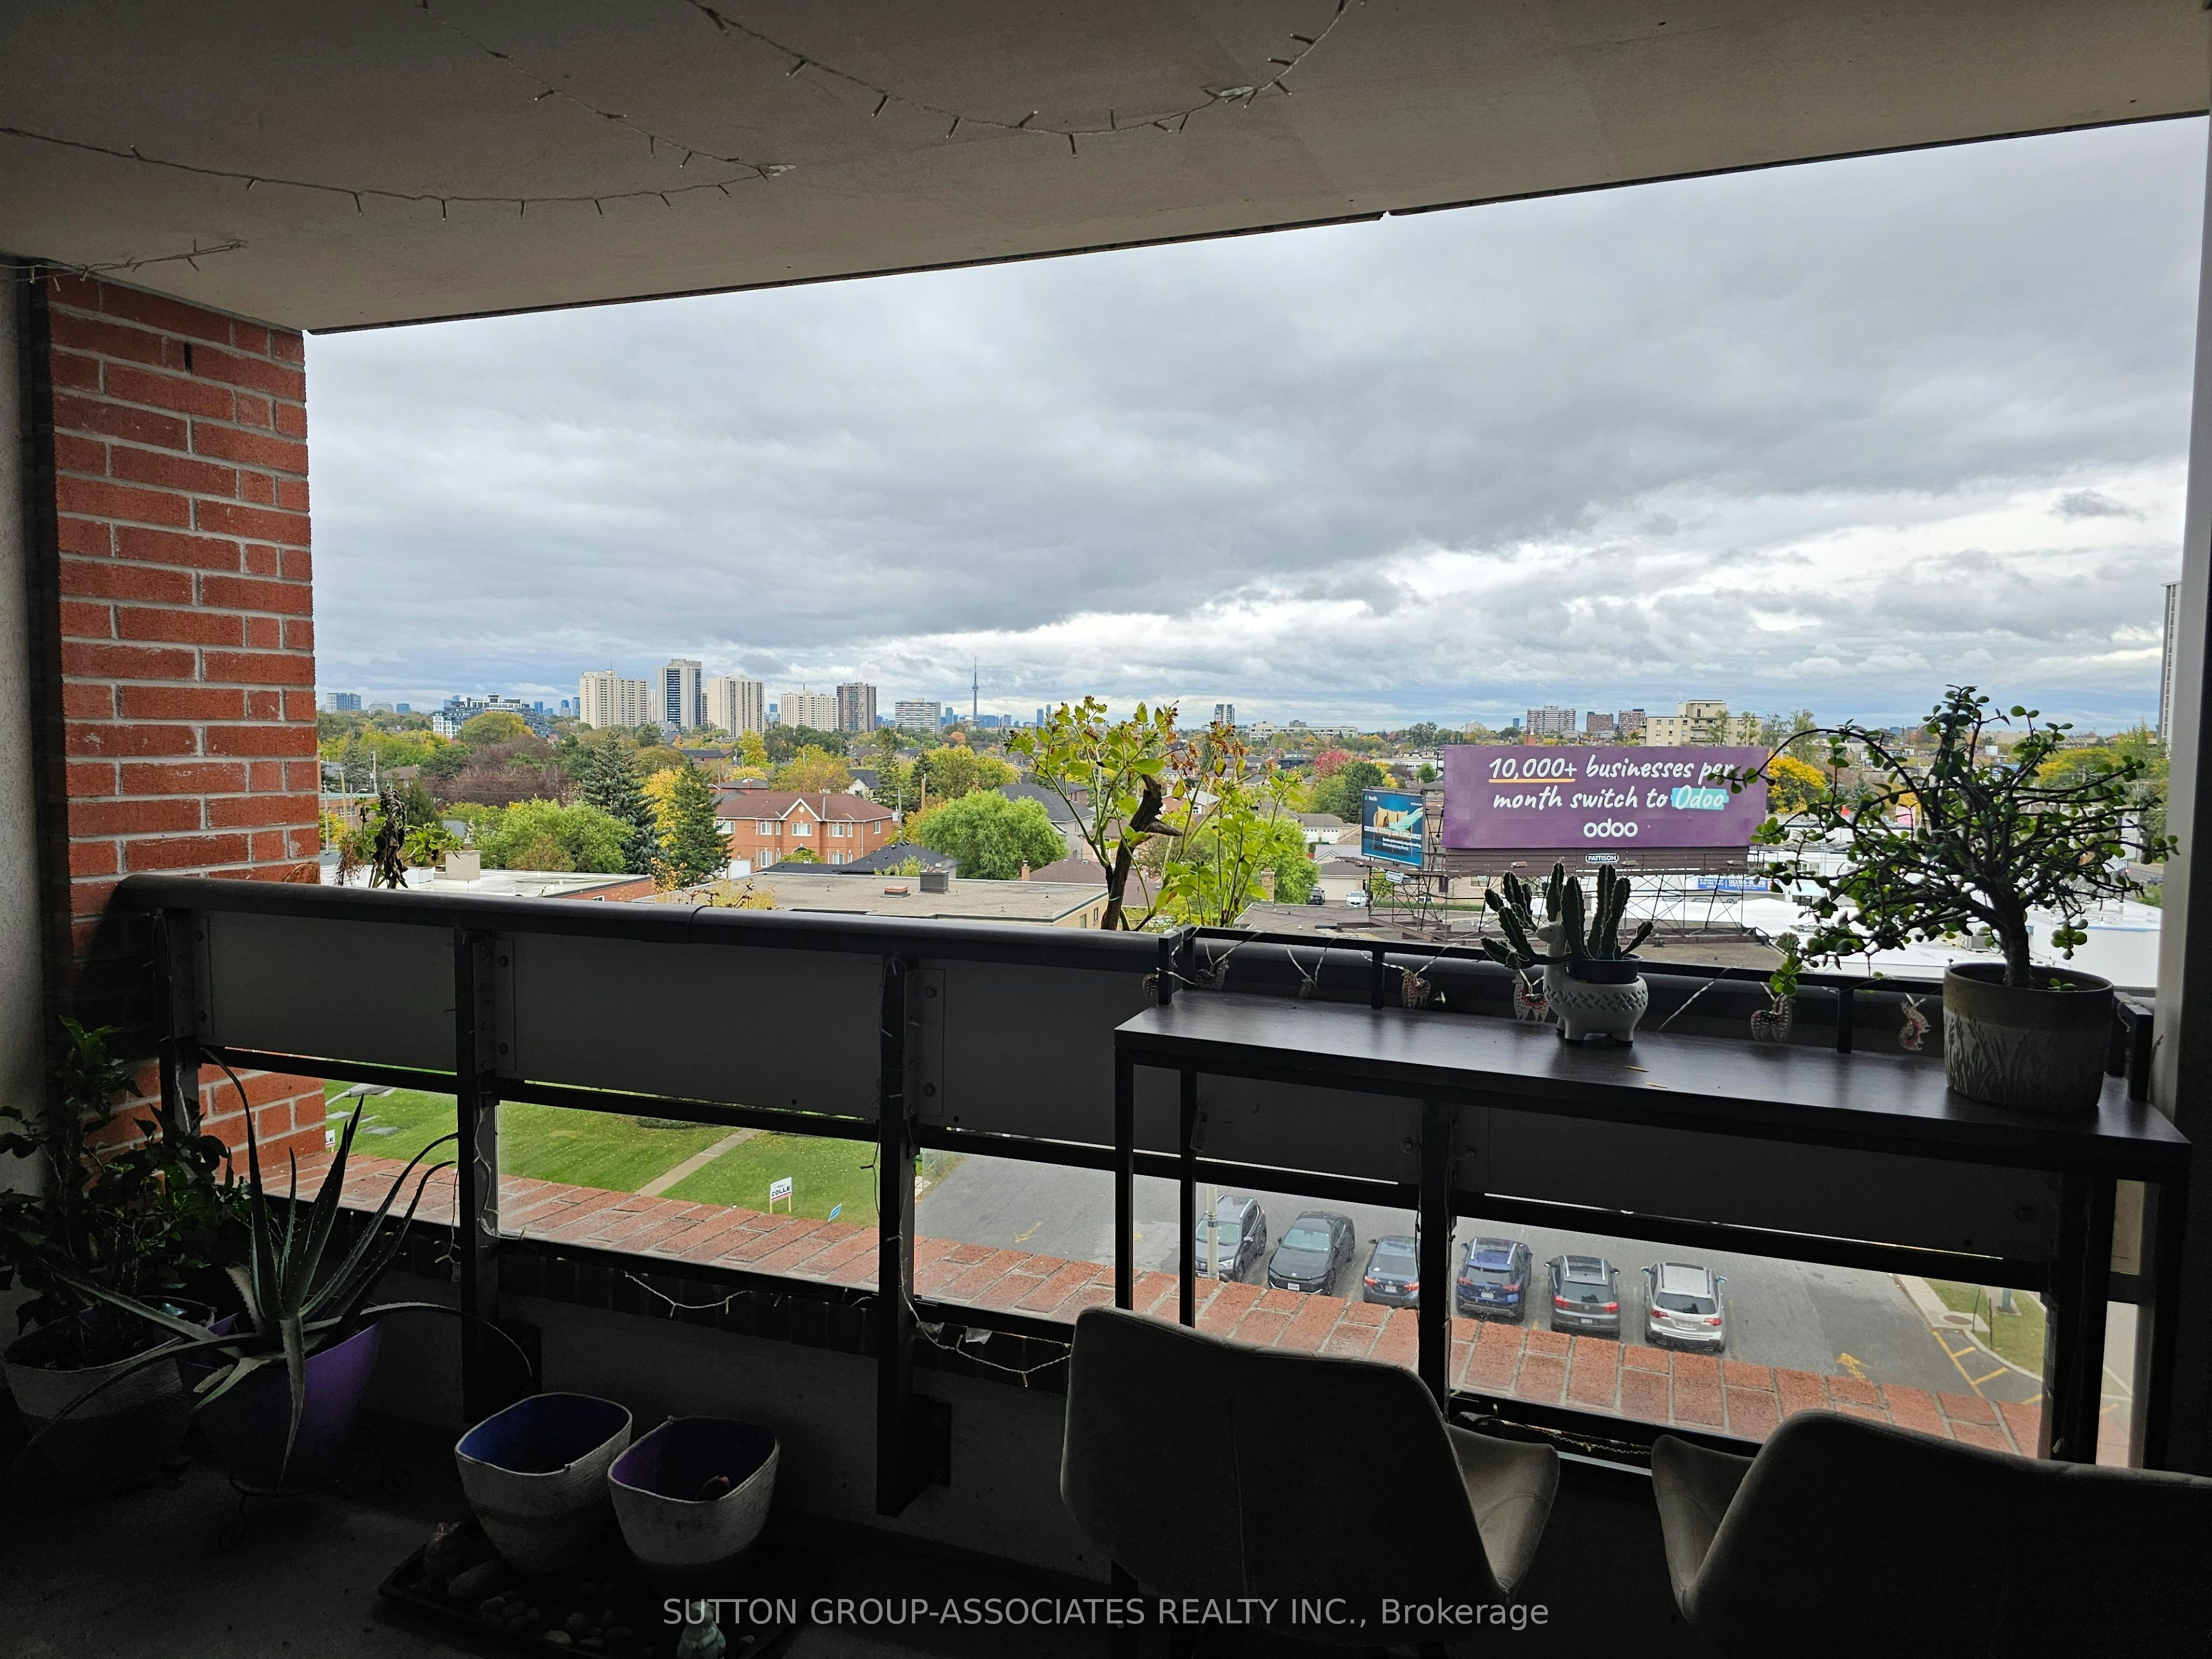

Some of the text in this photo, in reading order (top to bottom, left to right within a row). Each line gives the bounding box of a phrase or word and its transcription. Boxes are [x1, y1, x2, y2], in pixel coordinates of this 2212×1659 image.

[1489, 754, 1734, 785] 10,000+ businesses per
[1493, 785, 1724, 810] month switch to Odoo
[1584, 818, 1638, 838] odoo
[772, 1185, 790, 1196] COLLE
